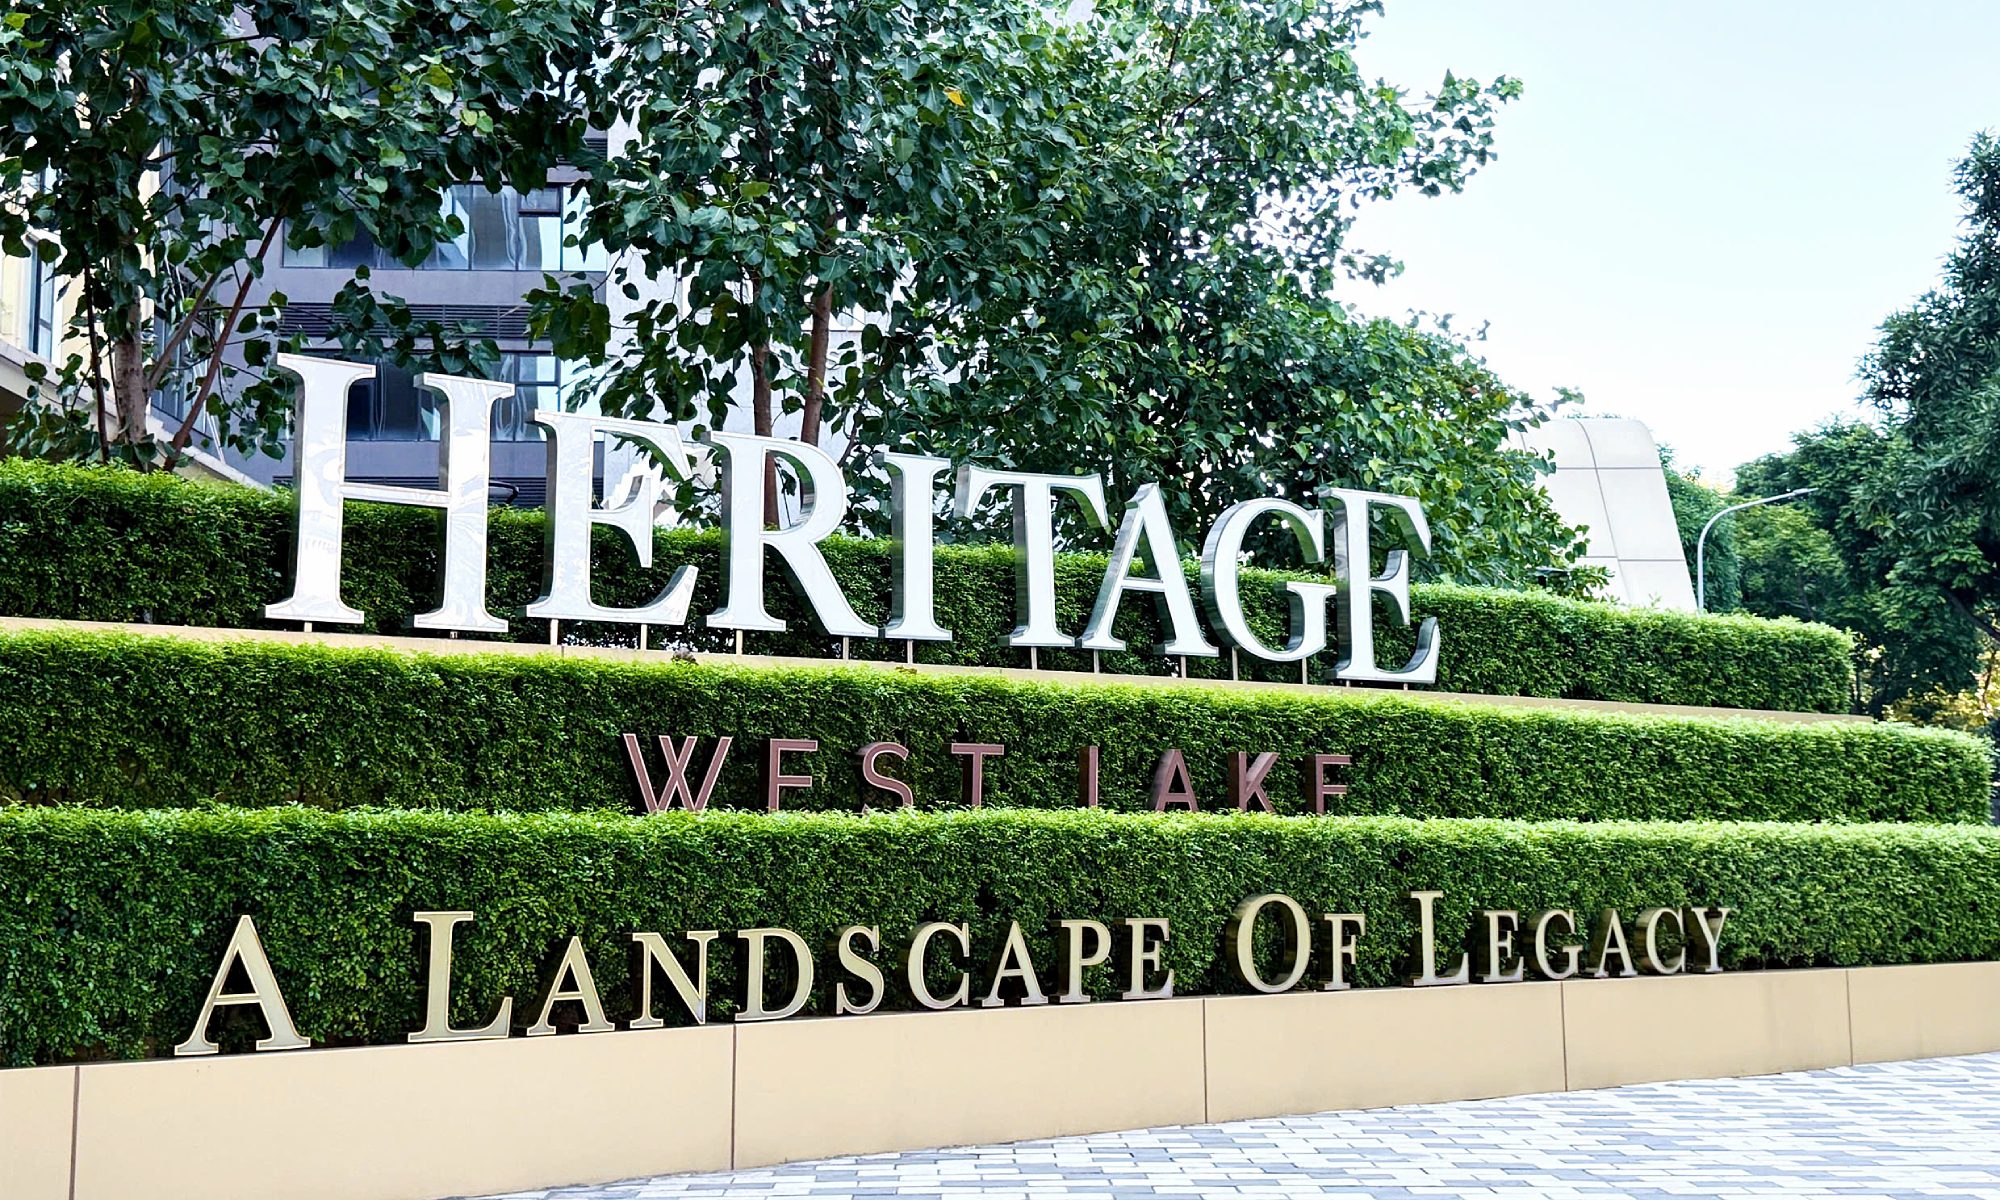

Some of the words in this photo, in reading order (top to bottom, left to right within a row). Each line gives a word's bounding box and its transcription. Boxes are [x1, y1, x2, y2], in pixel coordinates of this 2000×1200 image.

[265, 352, 1441, 688] HERITAGE
[622, 732, 1006, 814] WEST
[173, 914, 312, 1057] A
[406, 909, 1176, 1044] LANDSCAPE
[1232, 893, 1368, 994] OF
[1410, 890, 1732, 988] LEGACY
